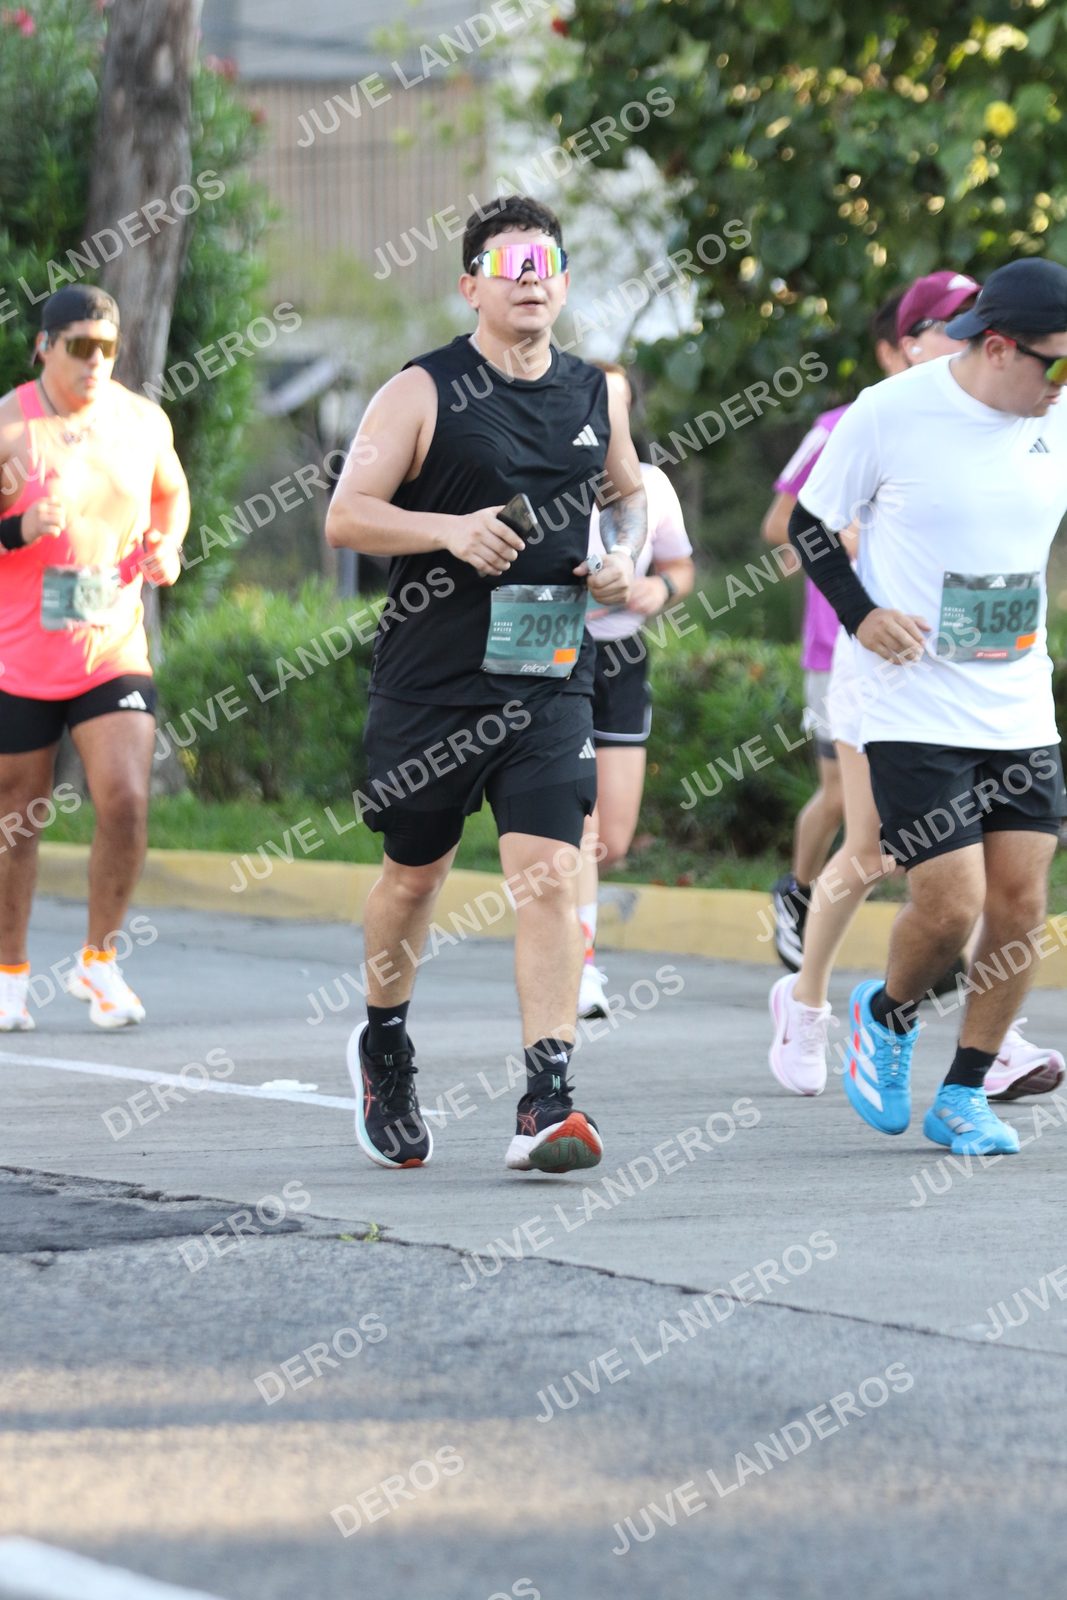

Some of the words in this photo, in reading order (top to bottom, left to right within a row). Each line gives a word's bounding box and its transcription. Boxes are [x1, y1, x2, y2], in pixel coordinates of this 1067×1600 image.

[516, 613, 581, 648] 2981
[972, 599, 1038, 634] 1582
[520, 663, 550, 673] telcel
